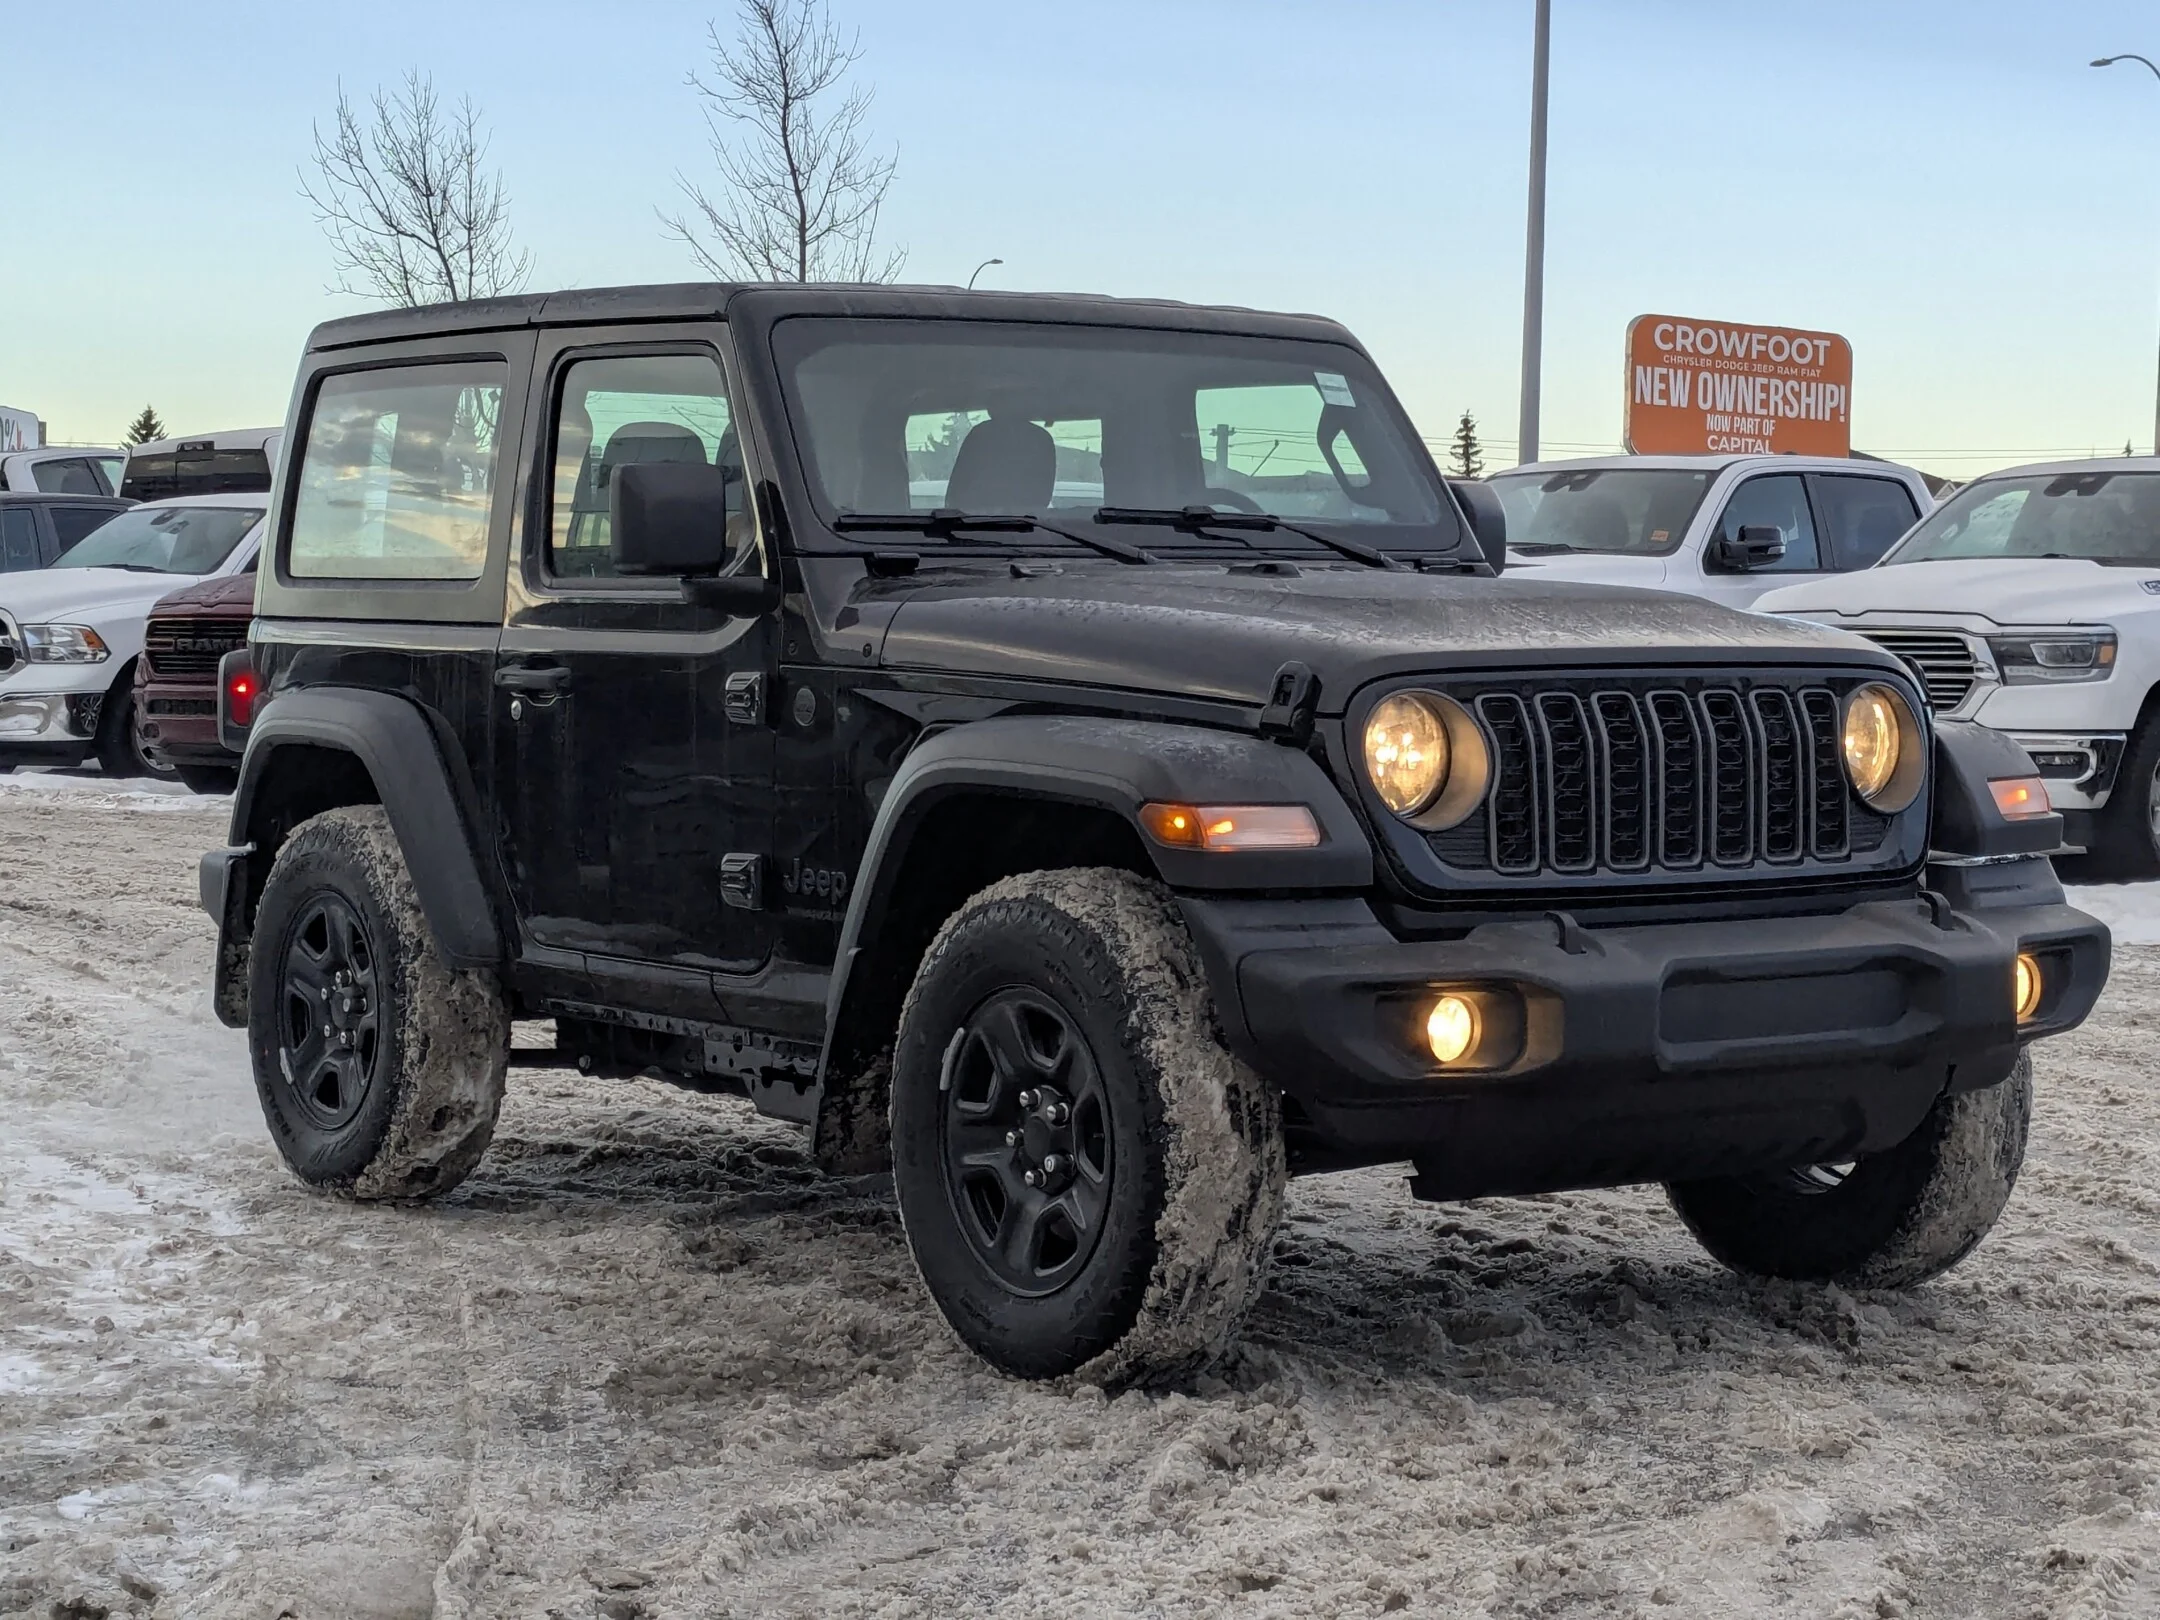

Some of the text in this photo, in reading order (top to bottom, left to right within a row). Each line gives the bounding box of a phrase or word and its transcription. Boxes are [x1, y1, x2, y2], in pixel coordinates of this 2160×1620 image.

[1654, 323, 1831, 366] CROWFOOT
[1663, 355, 1821, 378] CHRYSLER DODGE JEEP RAM FIAT
[1635, 366, 1846, 422] NEW OWNERSHIP!
[1706, 413, 1776, 437] NOW PART OF
[1707, 435, 1773, 455] CAPITAL
[783, 857, 847, 905] Jeep
